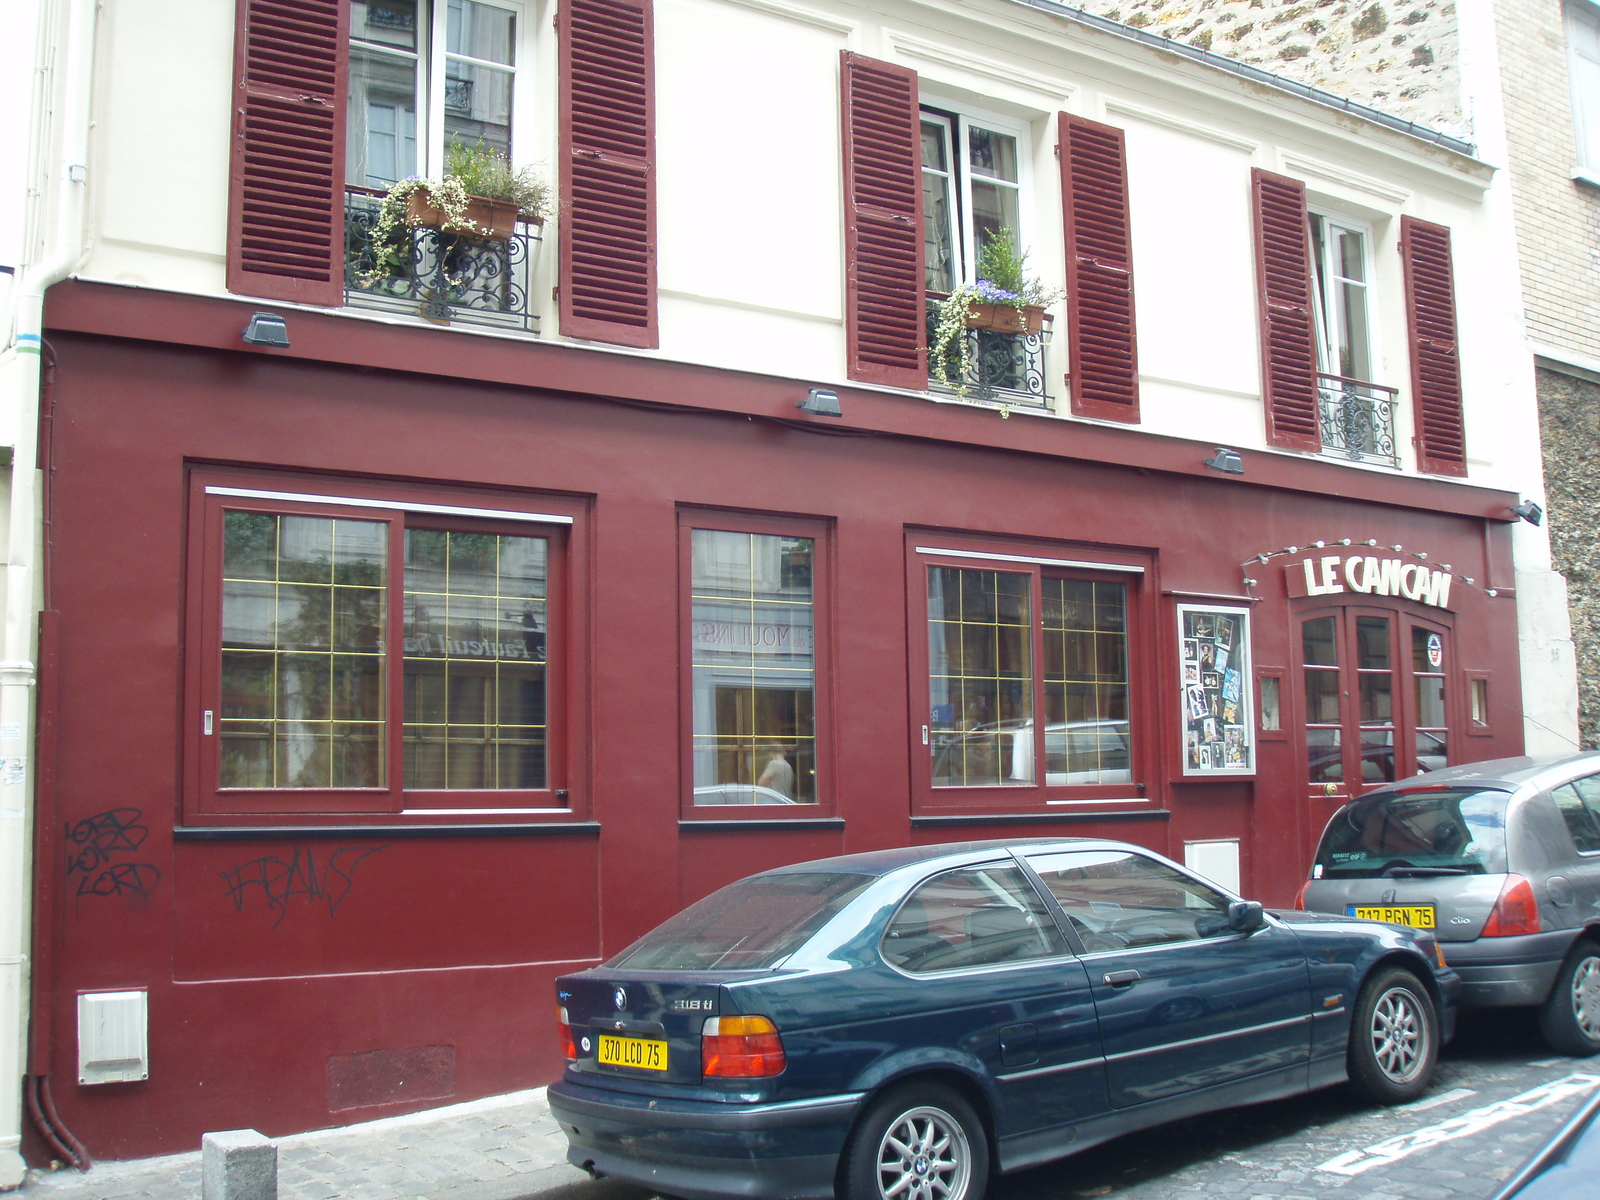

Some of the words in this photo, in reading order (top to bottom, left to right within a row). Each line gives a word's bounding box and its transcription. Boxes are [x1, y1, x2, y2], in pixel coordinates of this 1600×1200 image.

[1303, 556, 1344, 596] LE
[1345, 556, 1452, 608] CANCAN
[1385, 909, 1411, 926] PGN
[1415, 909, 1431, 926] 75
[604, 1039, 620, 1062] 370
[624, 1041, 642, 1065] LCD
[647, 1043, 660, 1066] 75
